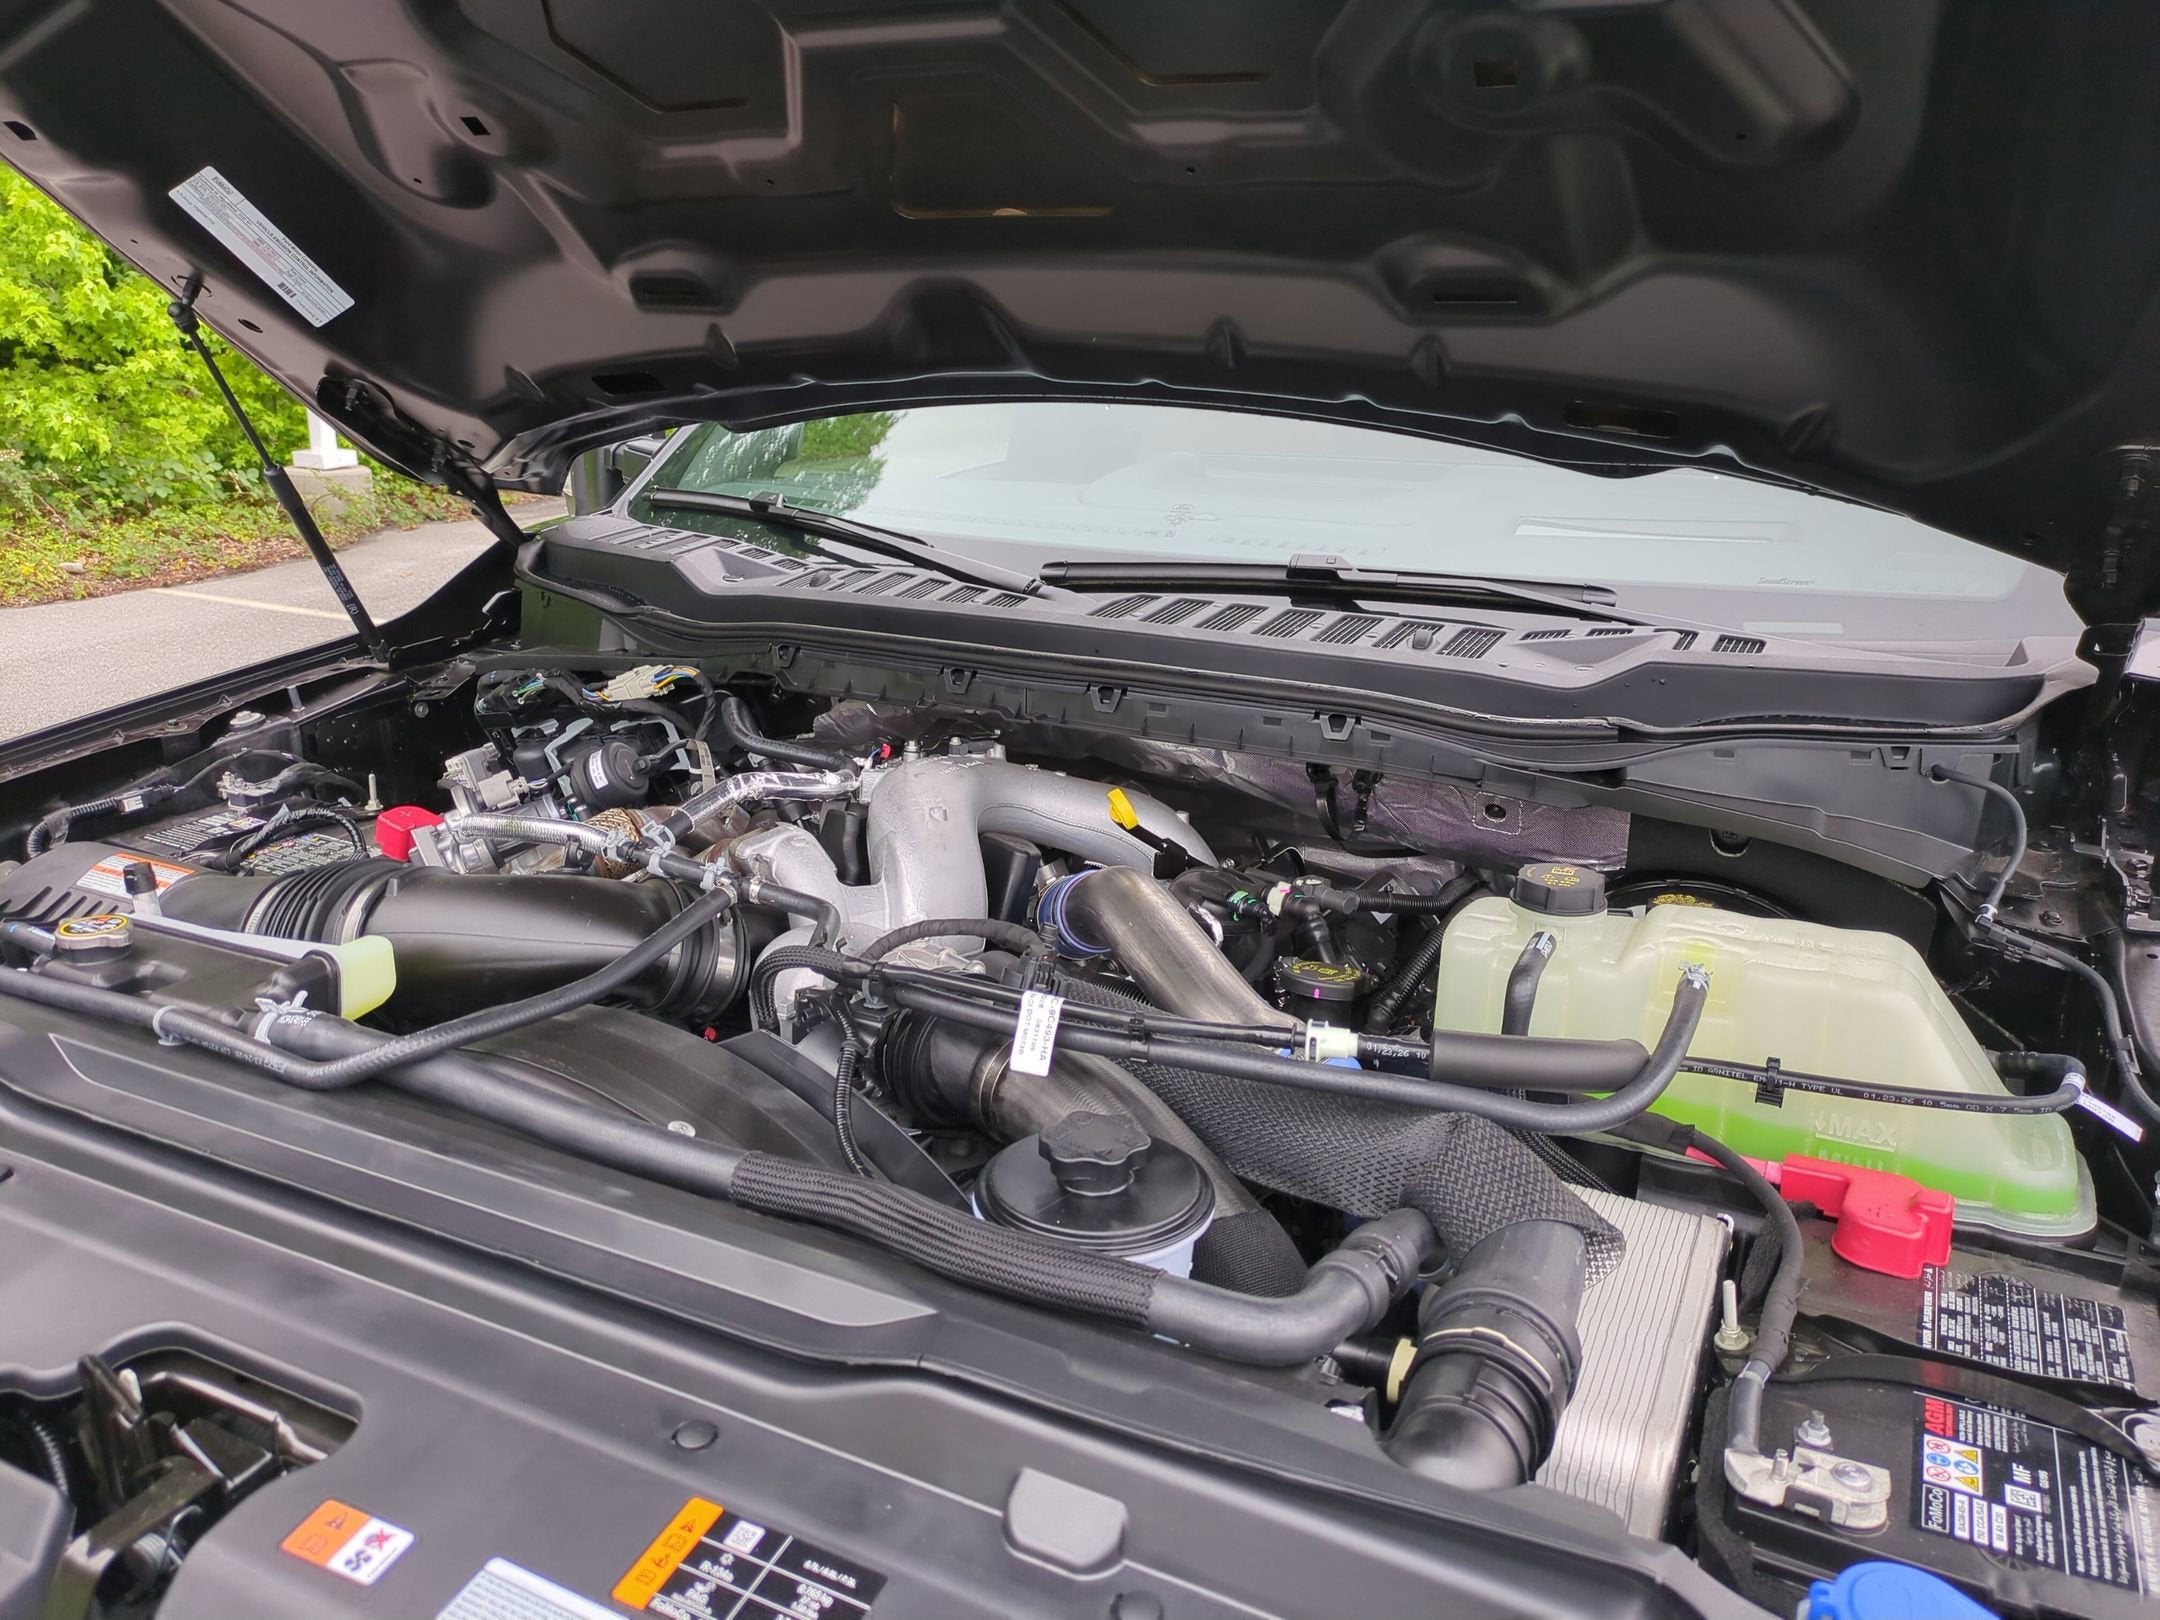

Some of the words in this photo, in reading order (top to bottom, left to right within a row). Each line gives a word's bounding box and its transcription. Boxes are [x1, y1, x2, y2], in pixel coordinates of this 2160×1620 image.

[272, 235, 293, 254] EMISSION
[291, 253, 309, 270] CONTROL
[307, 269, 334, 293] INFORMATION
[1801, 1082, 1826, 1092] TYPE
[1831, 1087, 1843, 1095] UL
[1828, 1113, 1897, 1147] MAX
[1925, 1399, 1945, 1435] AGM
[2013, 1463, 2031, 1484] MF
[1927, 1488, 1944, 1529] FoMoCo
